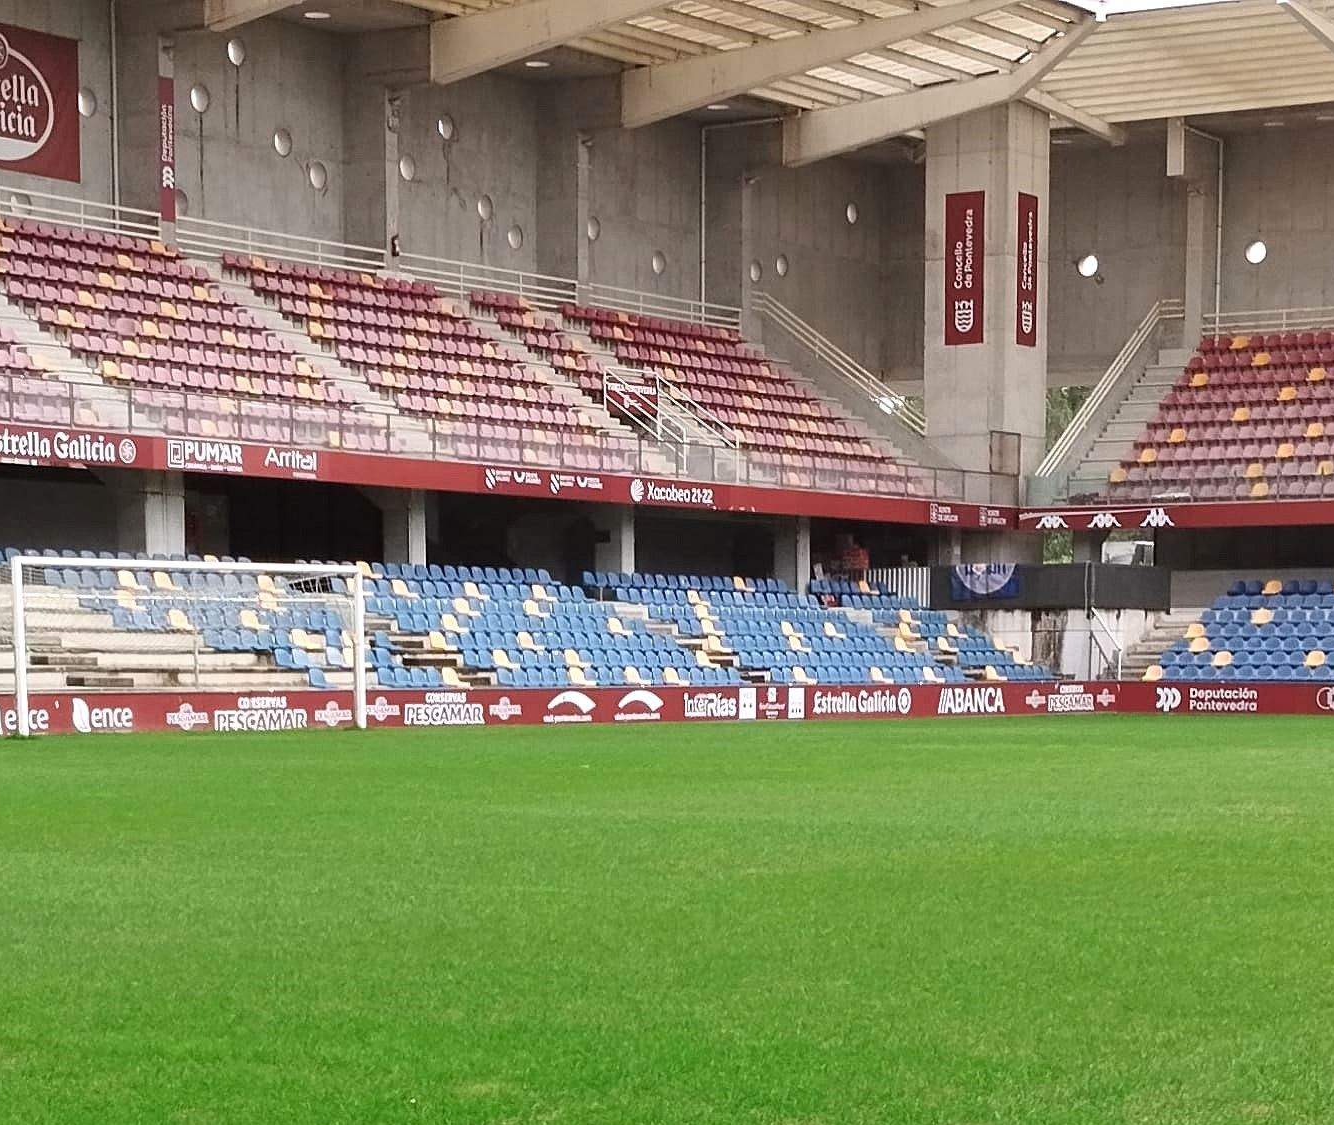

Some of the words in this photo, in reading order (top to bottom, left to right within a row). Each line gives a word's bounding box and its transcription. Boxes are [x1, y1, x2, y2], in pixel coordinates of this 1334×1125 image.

[964, 208, 974, 272] Pontevedra
[954, 241, 963, 289] Concello
[964, 275, 972, 288] de
[54, 433, 116, 463] Galicia
[265, 448, 317, 471] Arrital
[647, 481, 691, 503] Xacobeo
[813, 690, 857, 714] Estrella
[858, 689, 896, 713] Galicia
[944, 688, 1006, 713] ABANCA
[1189, 687, 1258, 701] Deputación
[1189, 699, 1258, 712] Pontevedra
[5, 708, 49, 731] ece
[90, 706, 133, 729] ence
[214, 708, 308, 732] PESCAMAR
[404, 704, 486, 726] PESCAMAR
